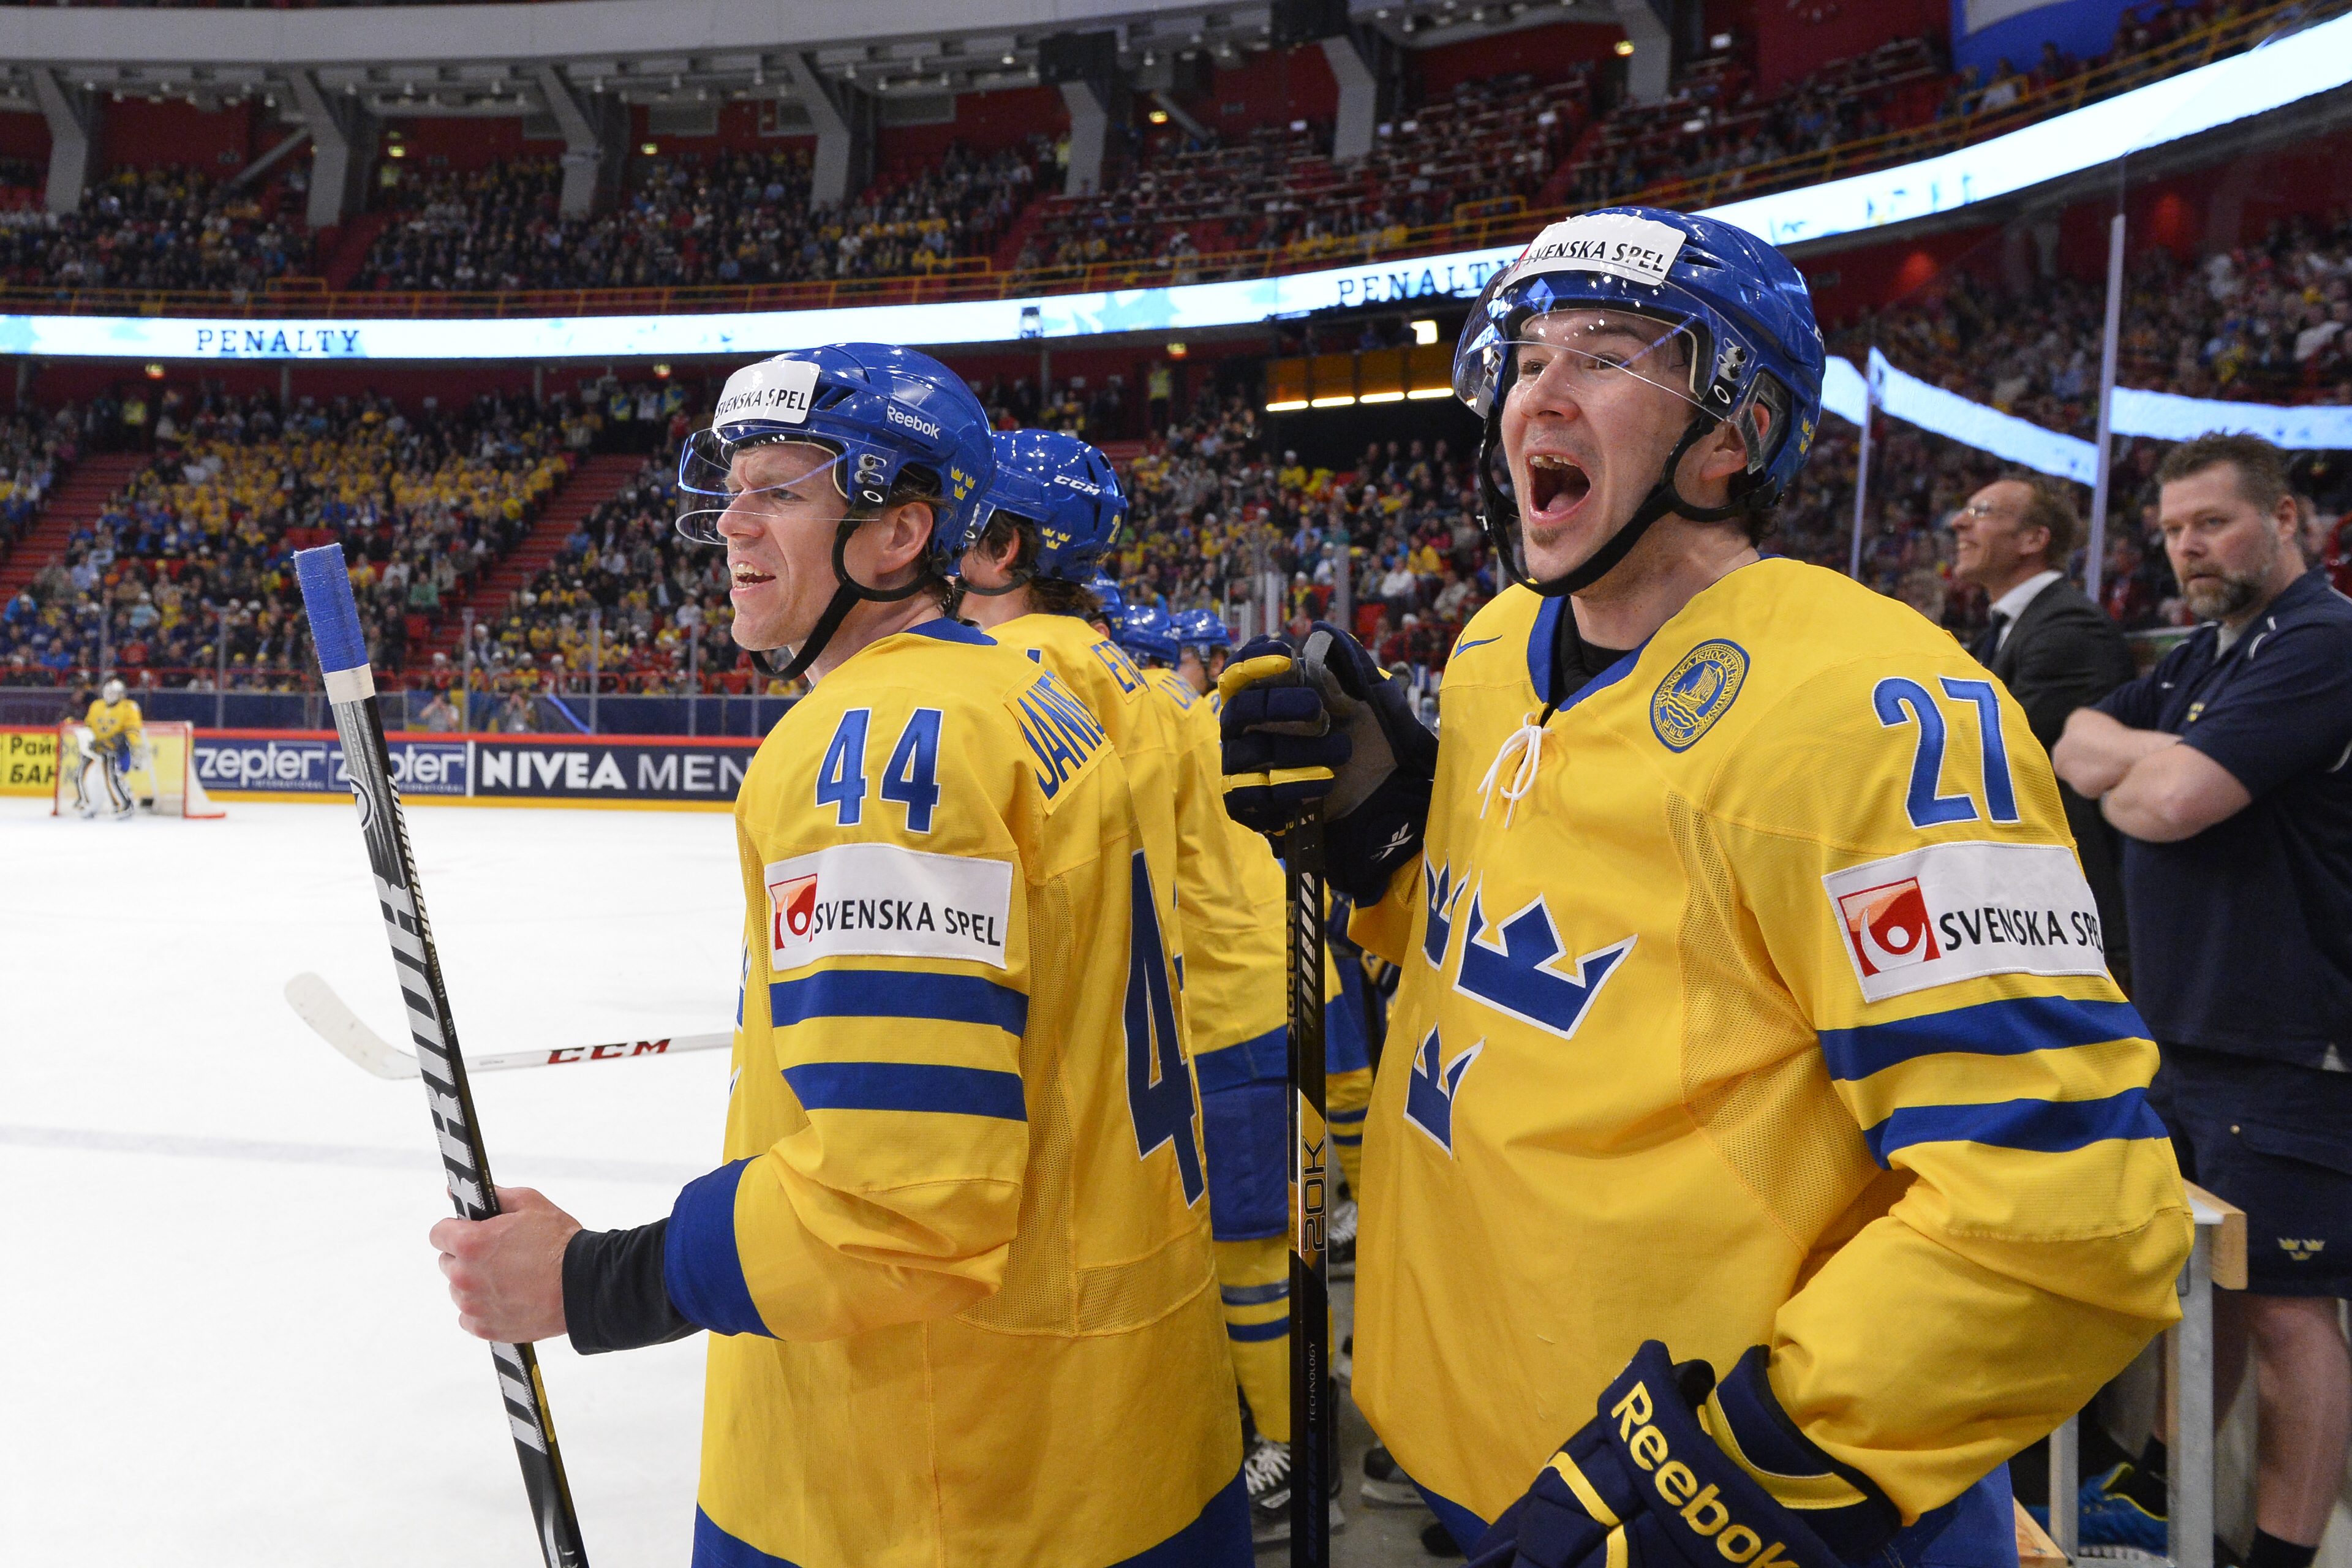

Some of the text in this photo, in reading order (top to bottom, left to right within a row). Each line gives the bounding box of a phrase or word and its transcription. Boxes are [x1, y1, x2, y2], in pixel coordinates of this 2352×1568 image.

[1523, 241, 1665, 273] SVENSKA SPEL
[197, 330, 360, 352] PENALTY
[715, 388, 807, 419] SVENSKA SPEL
[887, 404, 940, 440] Reebok
[1054, 475, 1101, 496] CCM
[194, 742, 325, 787] zepter
[481, 749, 753, 792] NIVEA MEN
[814, 707, 944, 835] 44
[1871, 673, 2021, 829] 27
[813, 899, 1001, 948] SVENSKA SPEL
[1939, 907, 2068, 951] SVENSKA
[548, 1038, 671, 1065] CCM
[1302, 1136, 1326, 1253] 20K
[1611, 1381, 1801, 1568] Reebok
